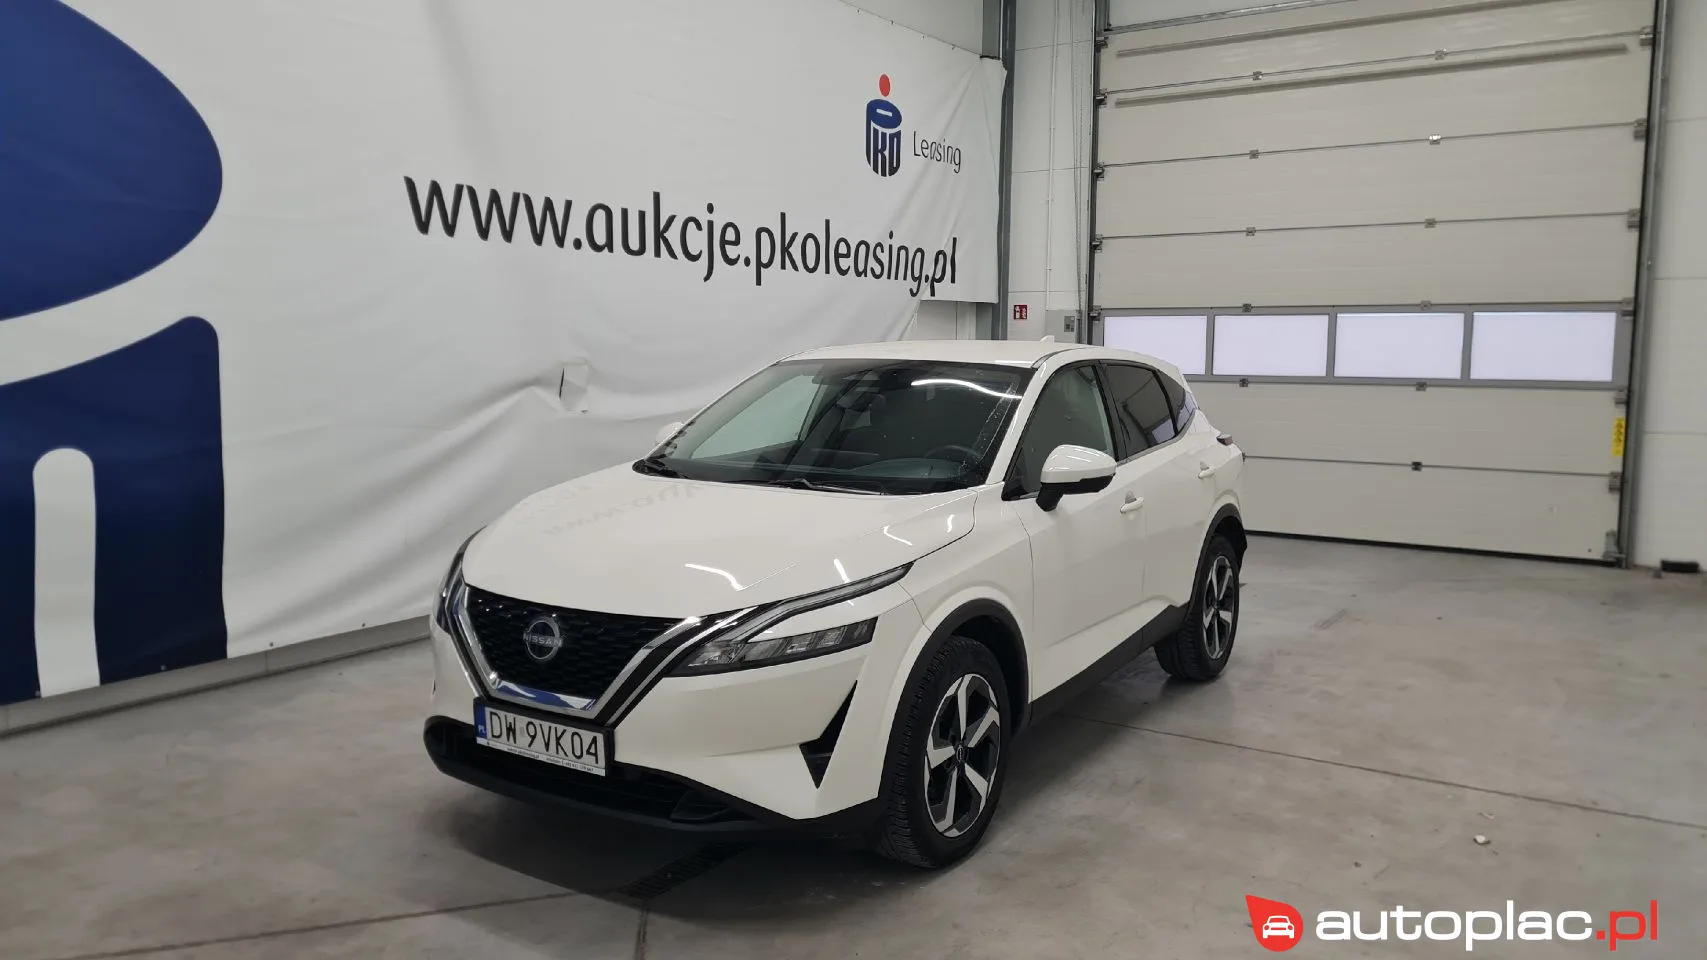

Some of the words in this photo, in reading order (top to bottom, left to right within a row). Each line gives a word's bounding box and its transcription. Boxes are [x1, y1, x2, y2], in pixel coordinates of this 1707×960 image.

[913, 130, 961, 173] Leasing
[404, 175, 957, 296] www.aukcje.pkoleasing.pl
[523, 632, 563, 647] NISSAN
[489, 711, 517, 744] DW
[525, 721, 599, 764] 9VK04
